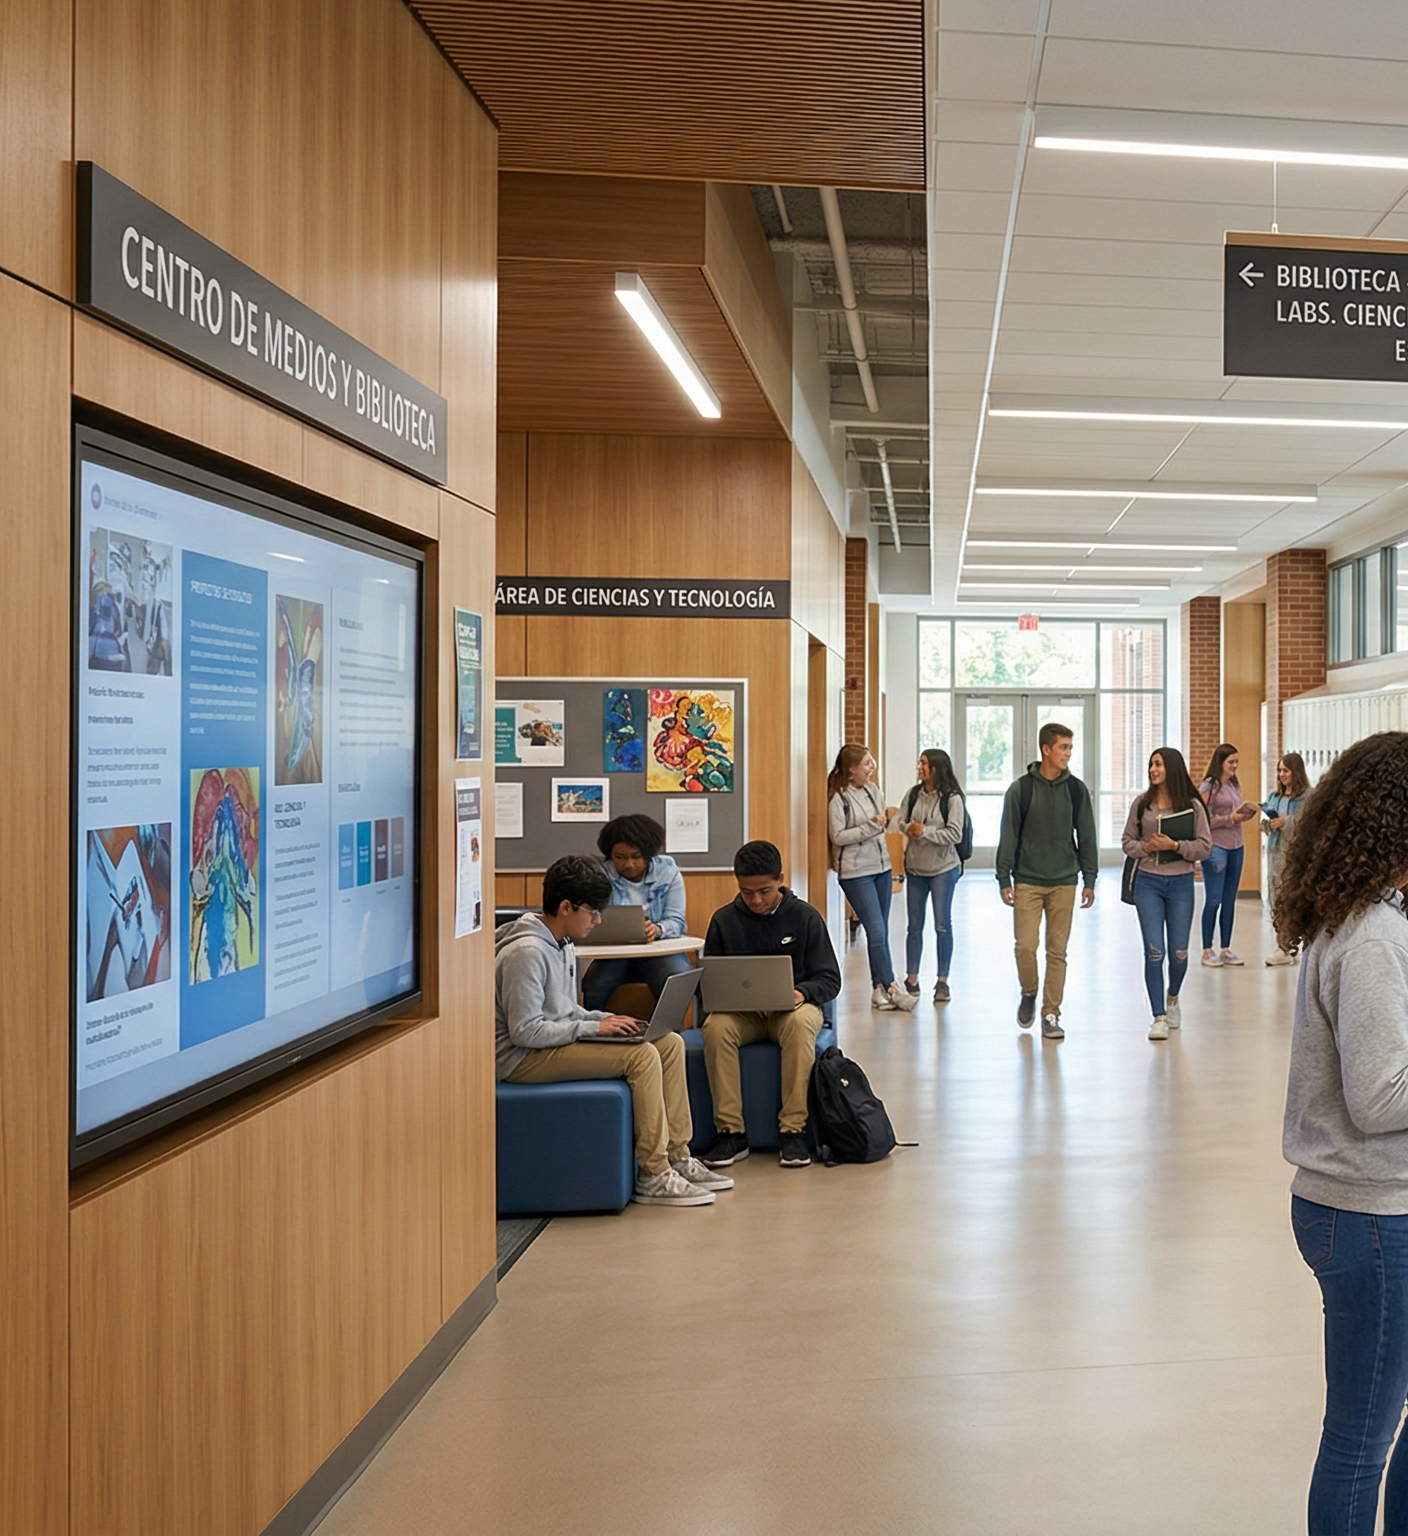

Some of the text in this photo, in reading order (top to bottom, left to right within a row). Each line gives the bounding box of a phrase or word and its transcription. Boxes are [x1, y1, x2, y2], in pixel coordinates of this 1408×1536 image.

[1277, 264, 1401, 292] BIBLIOTECA
[1276, 300, 1336, 324] LABS.
[121, 226, 436, 455] CENTRO DE MEDIOS Y BIBLIOTECA
[495, 582, 776, 608] ÁREA DE CIENCIAS Y TECNOLOGÍA
